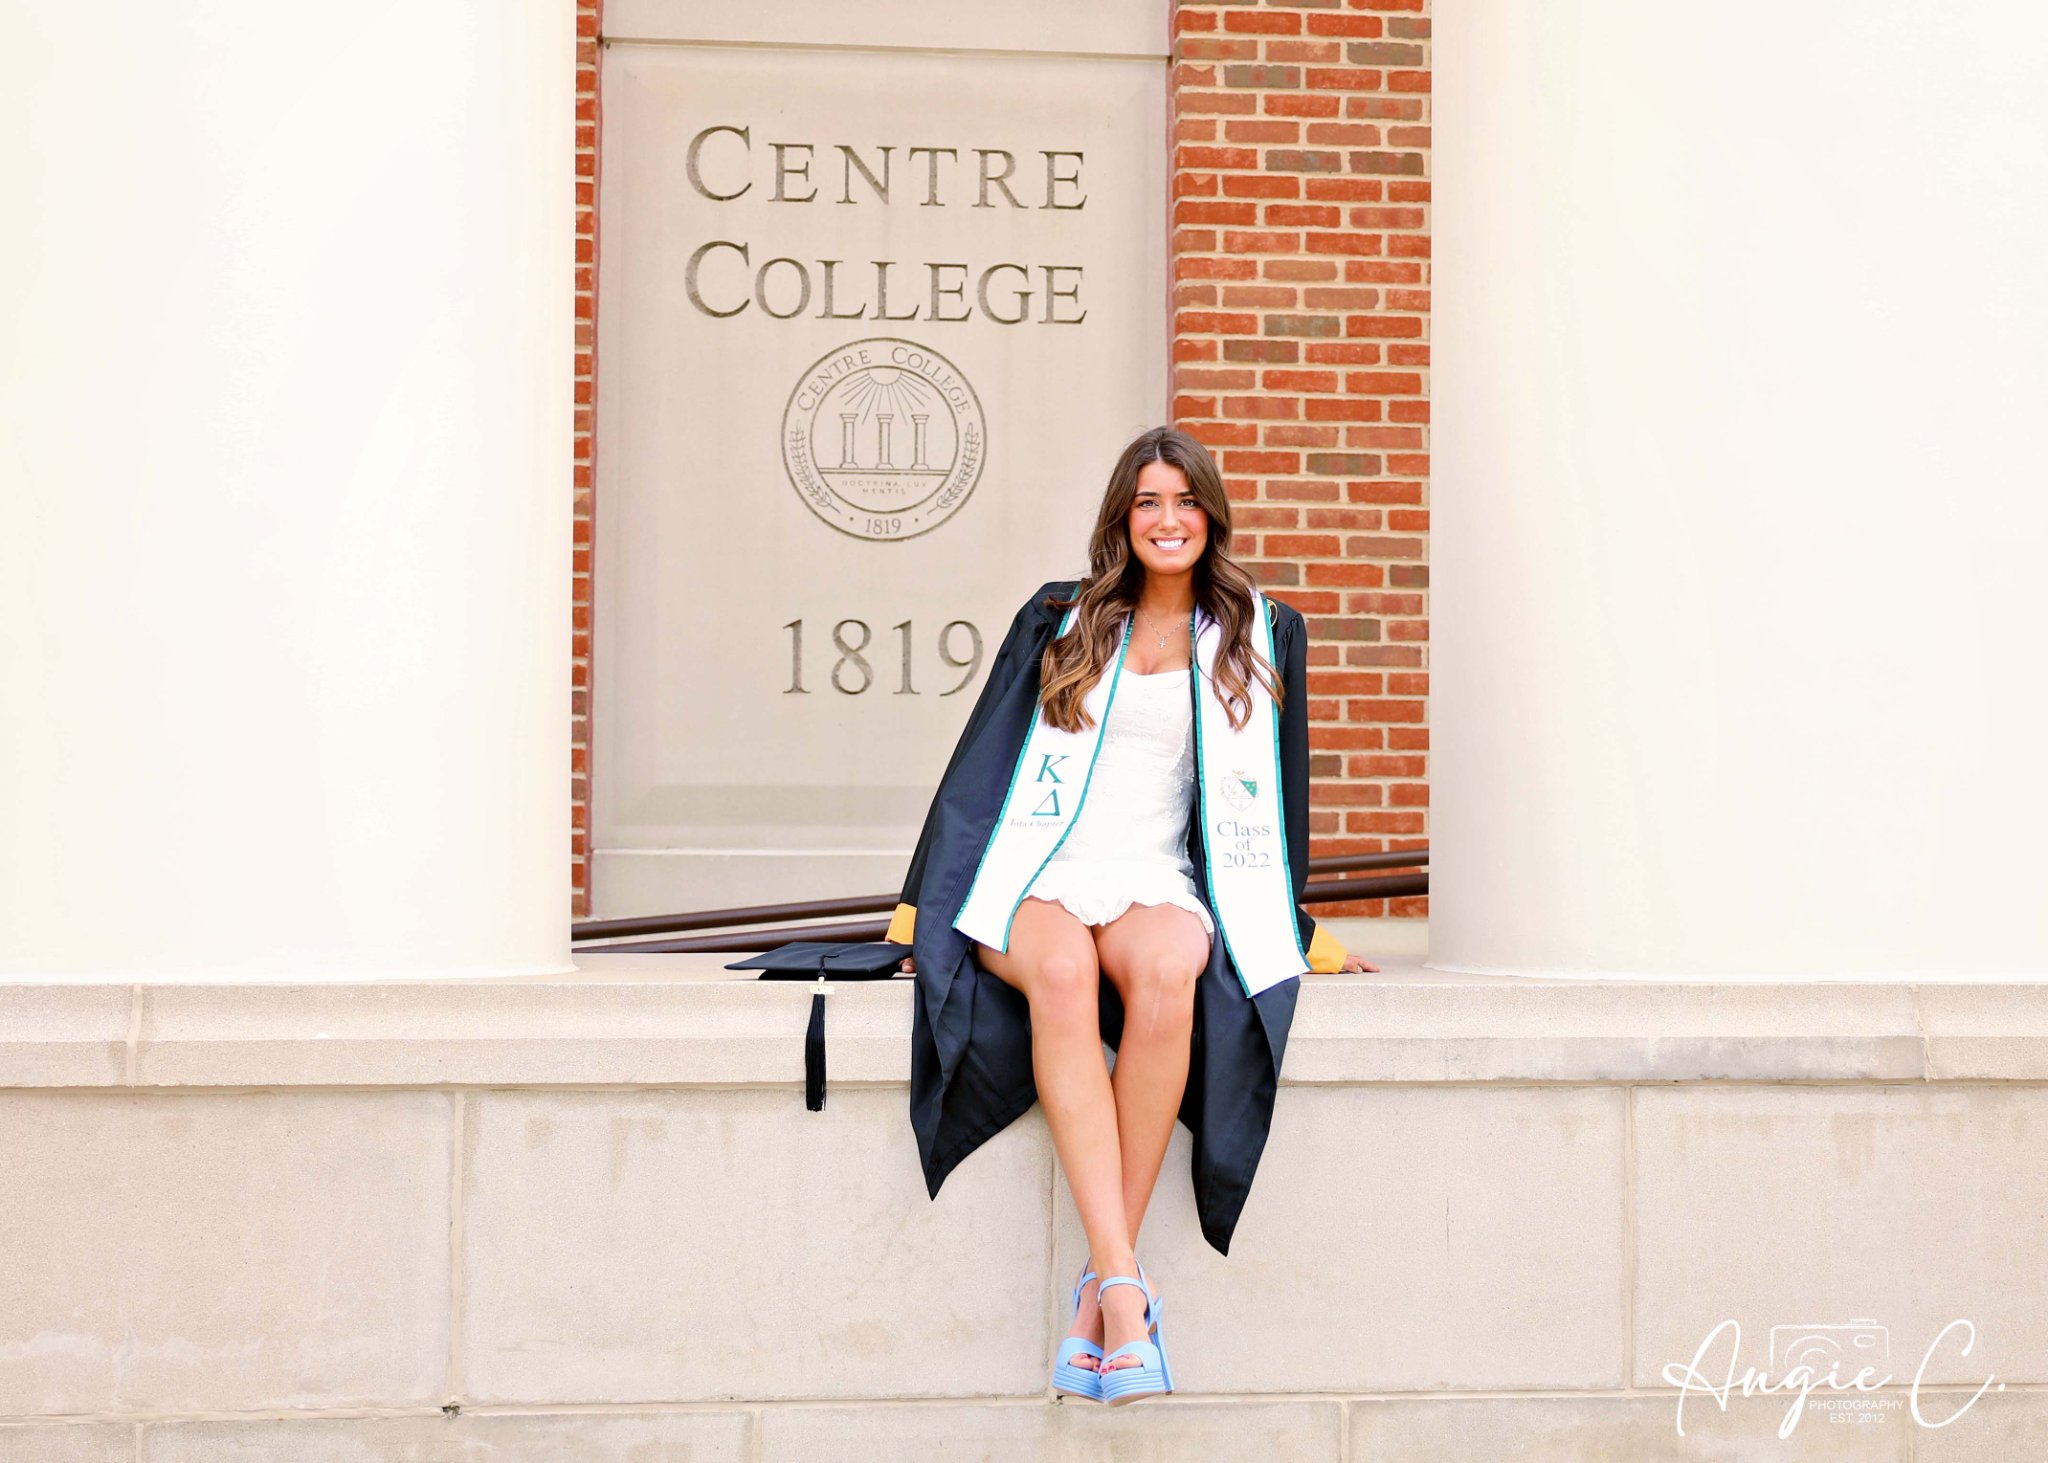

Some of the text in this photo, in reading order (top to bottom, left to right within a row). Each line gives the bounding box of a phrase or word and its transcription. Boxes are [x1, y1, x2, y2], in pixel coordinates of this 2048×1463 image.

[685, 125, 1088, 210] CENTRE
[685, 240, 1088, 326] COLLEGE
[796, 346, 971, 415] CENTRE COLLEGE
[864, 518, 902, 535] 1819
[782, 618, 984, 697] 1819
[1034, 753, 1071, 784] K
[1216, 821, 1271, 837] Class
[1235, 837, 1254, 851] of
[1222, 852, 1271, 868] 2022
